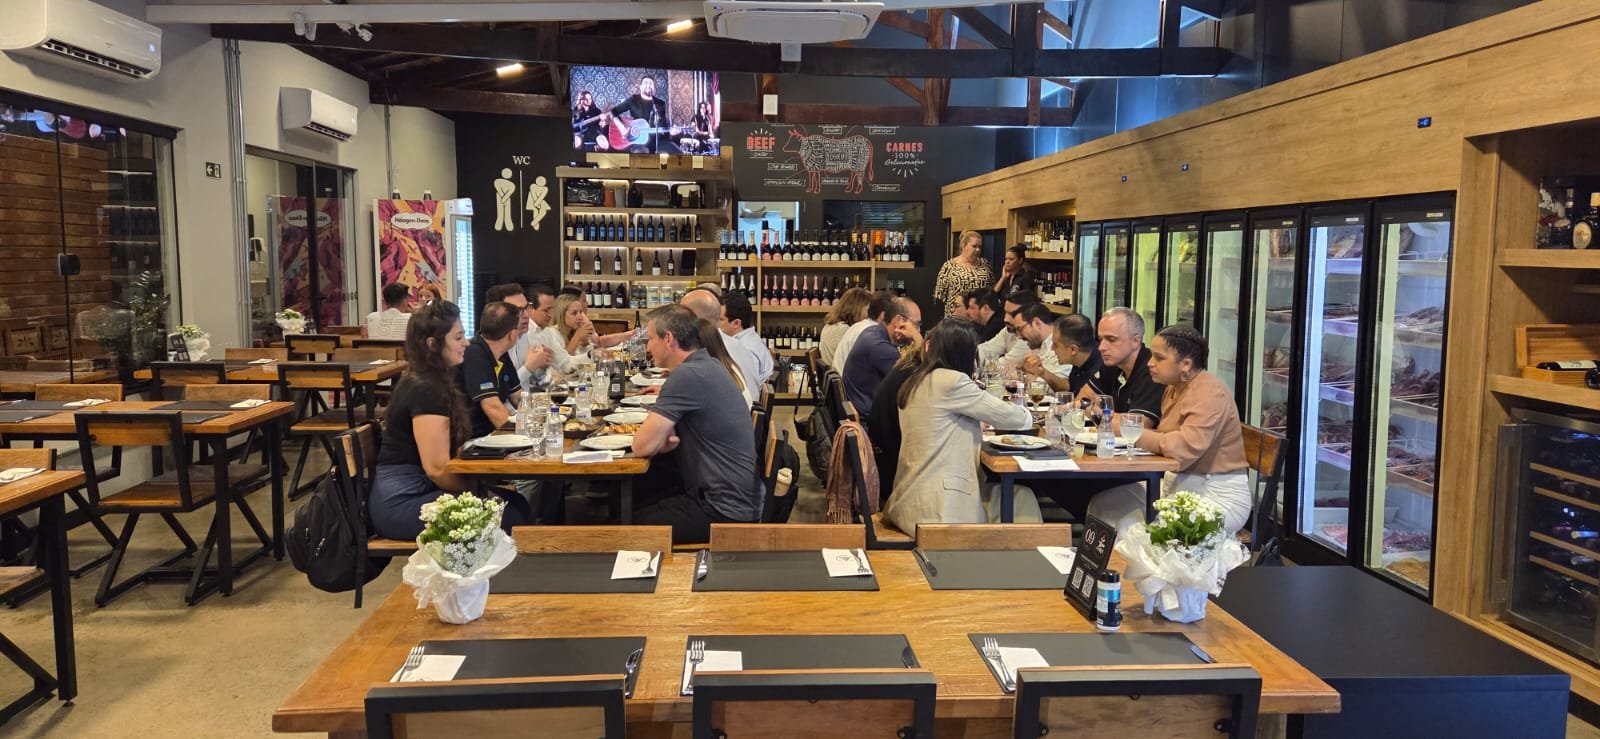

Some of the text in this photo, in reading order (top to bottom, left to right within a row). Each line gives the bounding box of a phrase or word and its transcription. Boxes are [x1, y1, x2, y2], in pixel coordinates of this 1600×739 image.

[746, 136, 776, 150] BEEF
[886, 142, 924, 153] CARNES
[512, 155, 531, 165] WC
[1085, 528, 1096, 545] 09
